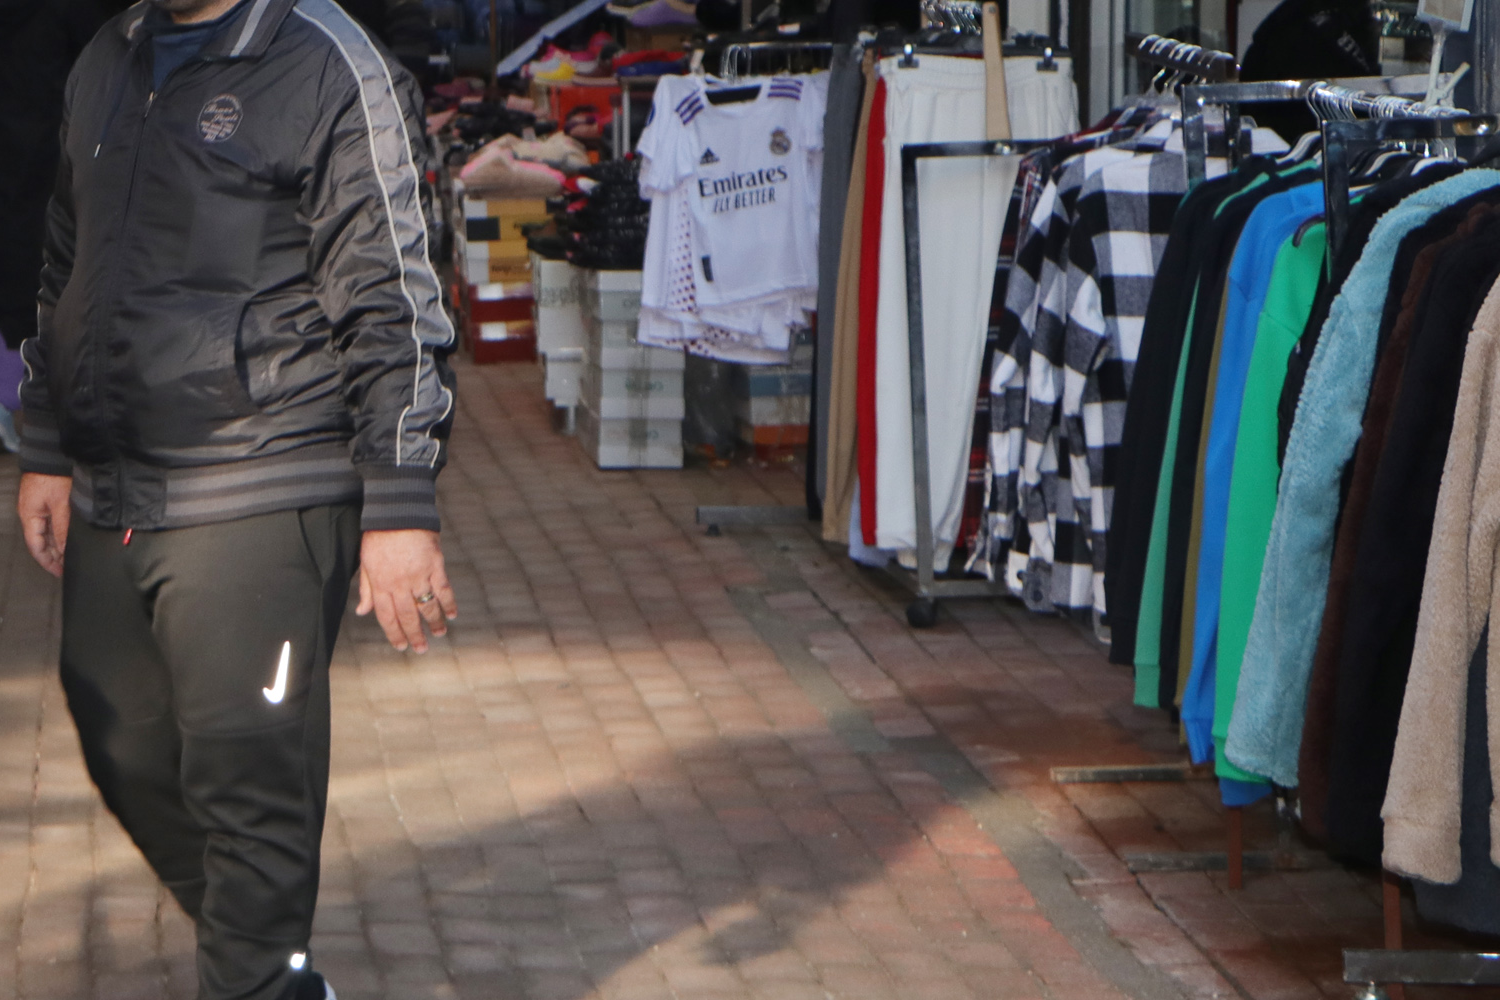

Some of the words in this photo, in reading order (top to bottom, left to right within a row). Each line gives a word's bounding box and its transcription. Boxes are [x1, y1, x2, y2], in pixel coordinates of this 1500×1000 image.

[699, 165, 787, 197] Emirates
[714, 197, 730, 213] FLY
[735, 187, 775, 209] BETTER
